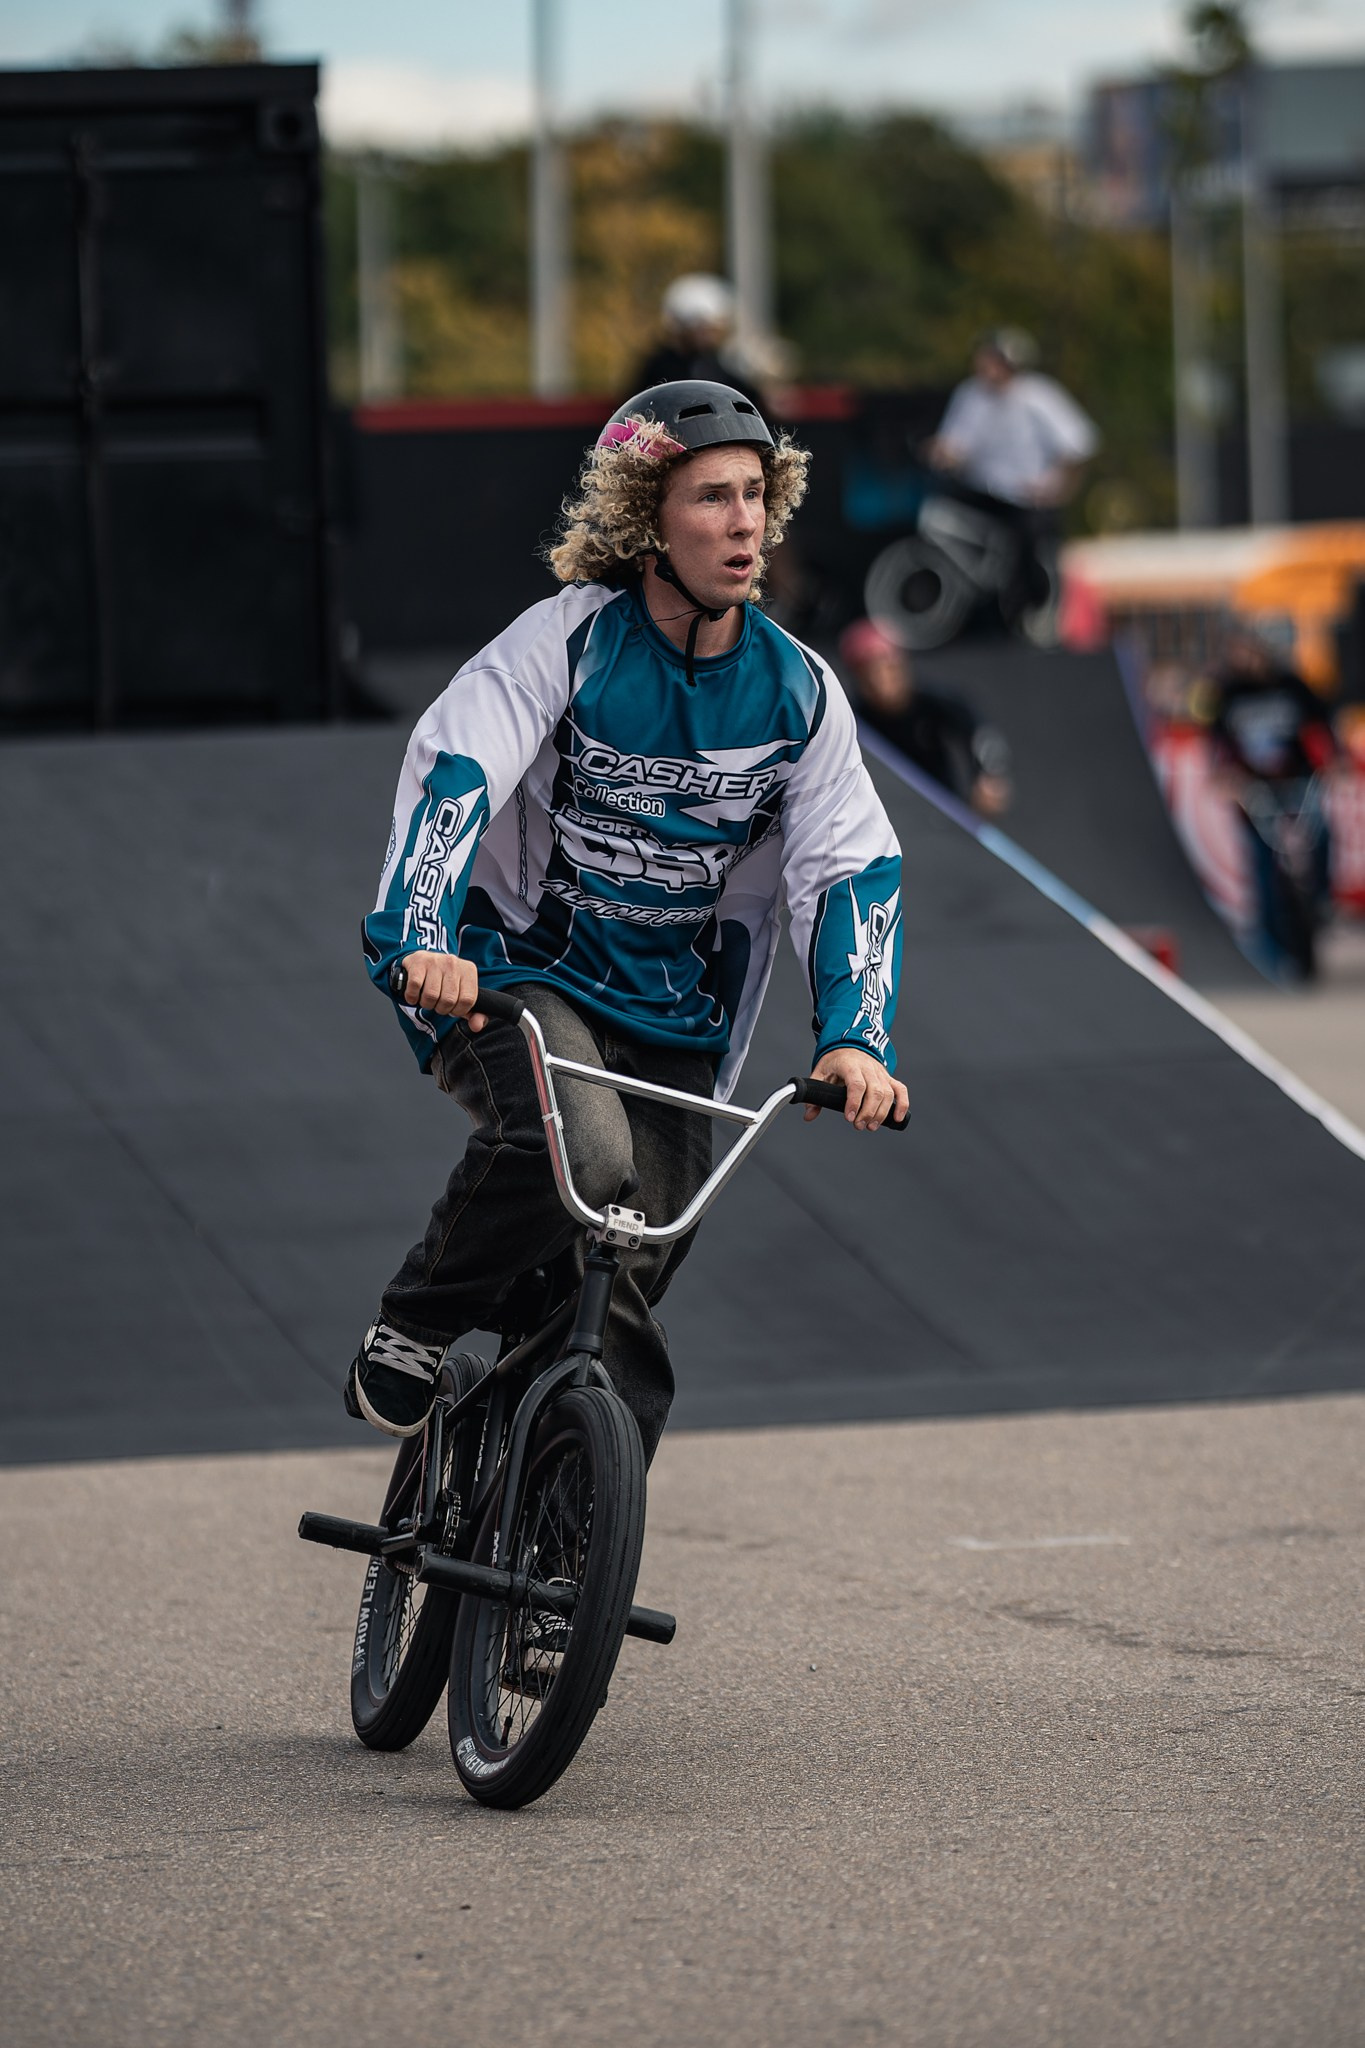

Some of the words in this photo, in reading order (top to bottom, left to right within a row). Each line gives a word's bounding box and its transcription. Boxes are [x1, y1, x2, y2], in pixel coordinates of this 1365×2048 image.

[574, 776, 666, 817] Collection
[578, 747, 778, 799] CASHER
[540, 879, 660, 928] ALPINE
